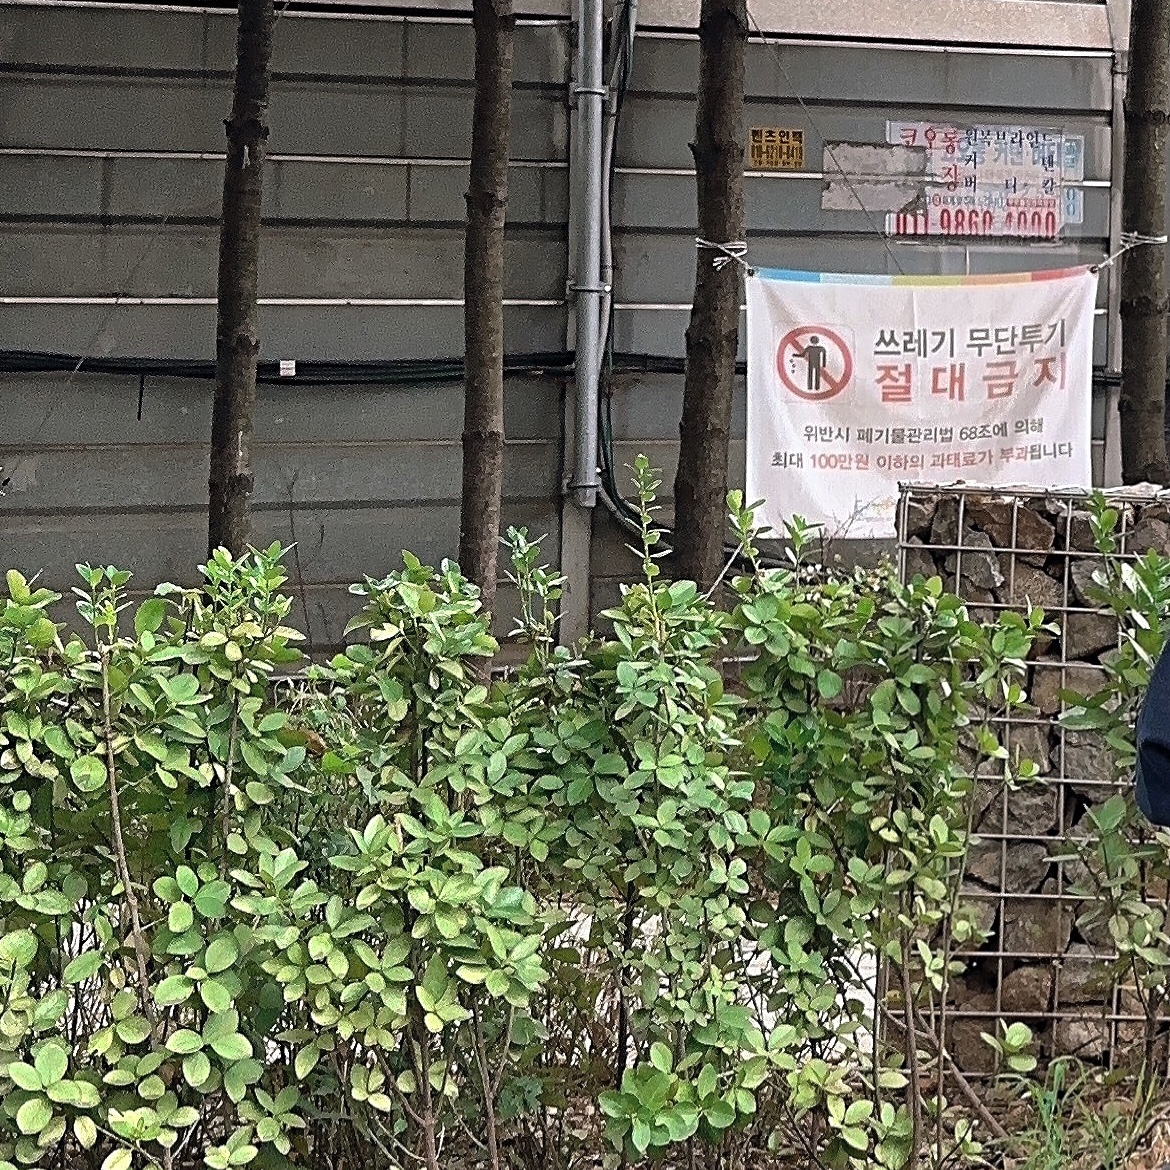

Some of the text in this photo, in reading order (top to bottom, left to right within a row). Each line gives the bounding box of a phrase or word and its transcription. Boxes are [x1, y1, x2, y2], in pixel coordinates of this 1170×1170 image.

[874, 318, 1066, 358] 쓰레기 무단투기
[803, 425, 850, 443] 위반시
[959, 422, 1008, 440] 68조에
[1014, 417, 1044, 434] 의해
[771, 441, 1074, 470] 최대 100만원 이하의 과태료가 부과됩니다
